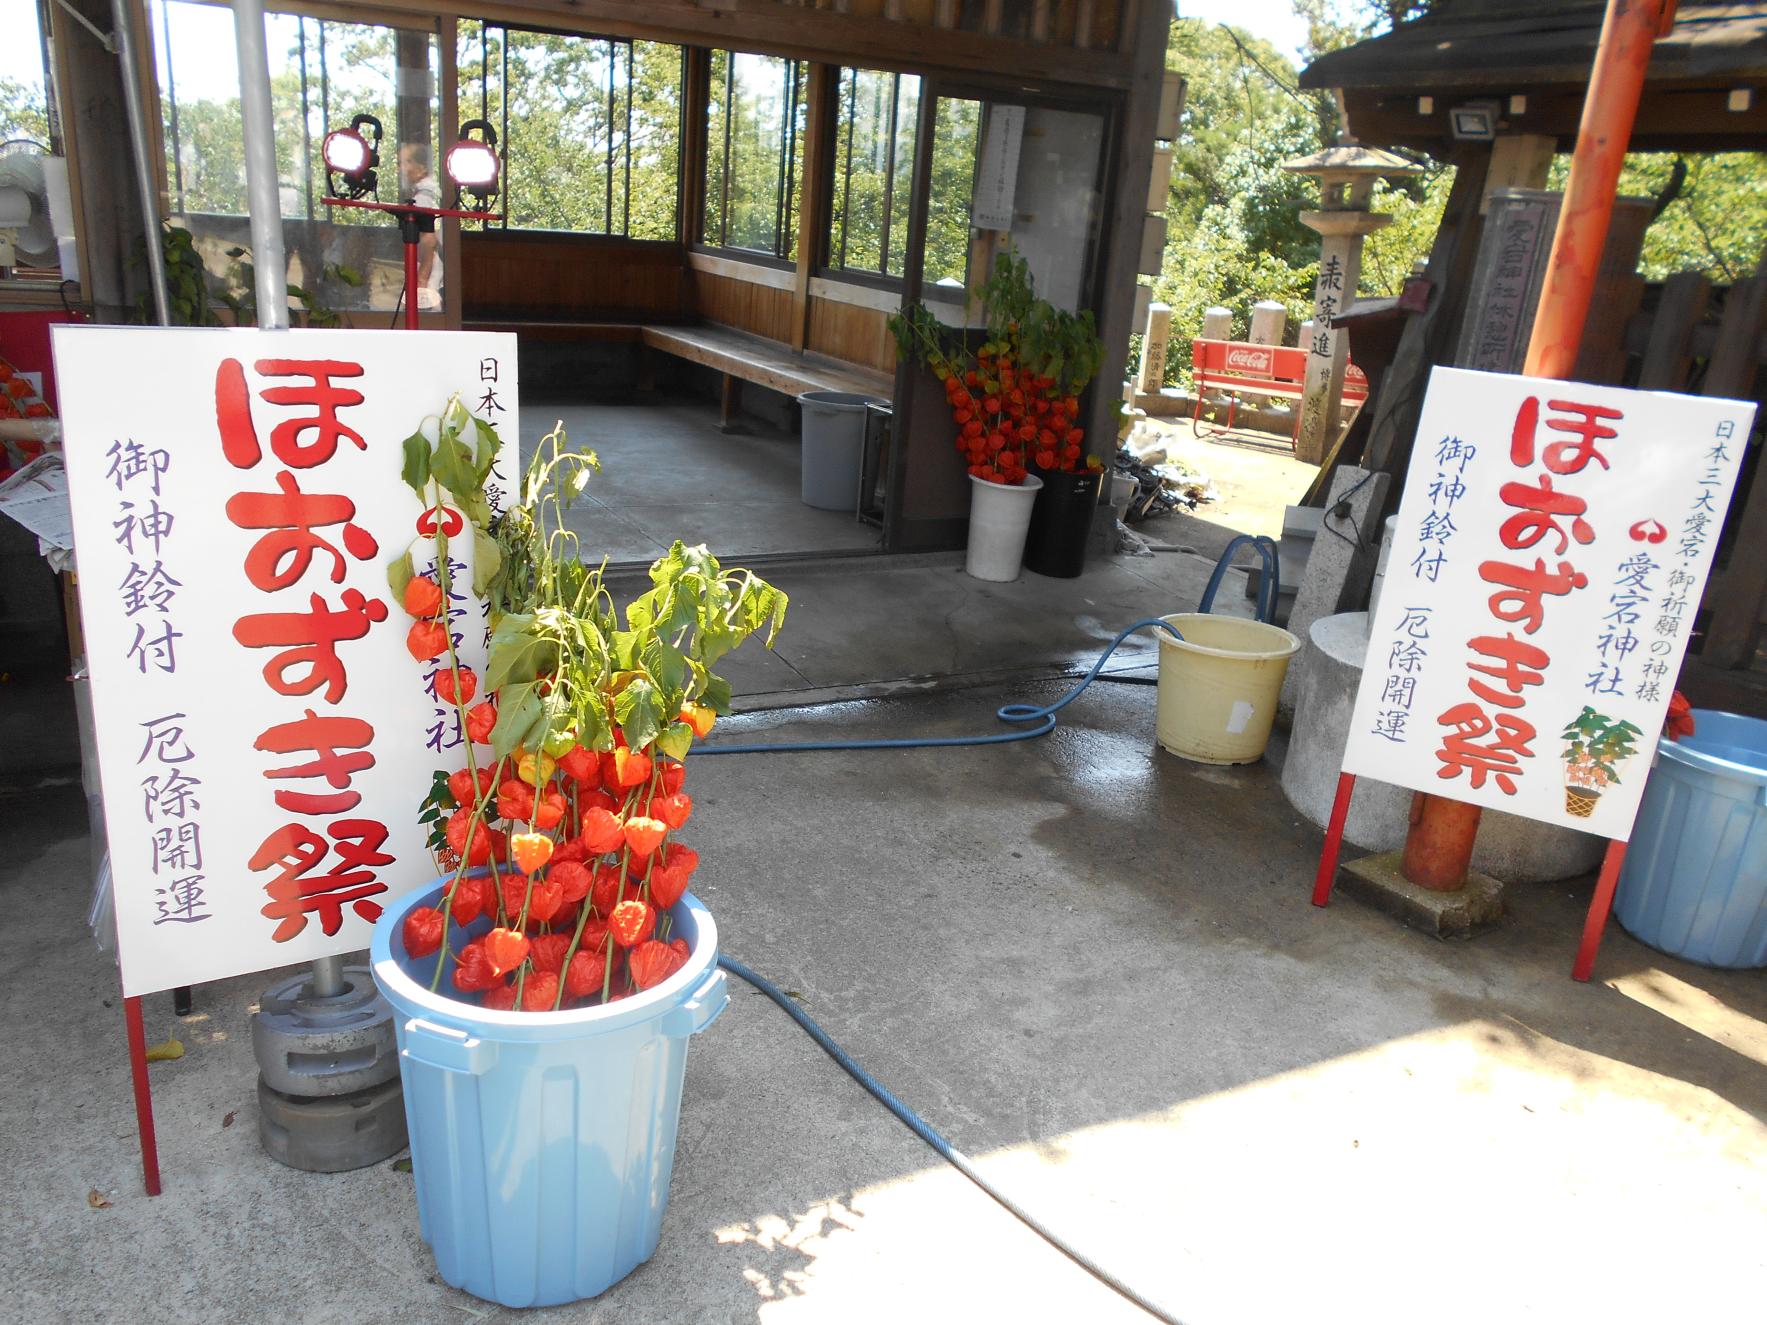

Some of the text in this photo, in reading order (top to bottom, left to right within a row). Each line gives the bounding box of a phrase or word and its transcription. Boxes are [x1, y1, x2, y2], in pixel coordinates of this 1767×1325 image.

[106, 438, 213, 926] 御神鈴付 厄除開運
[216, 358, 395, 942] ほおずき祭
[1370, 435, 1477, 743] 御神鈴付 厄除開運
[1435, 395, 1622, 795] ほおずき祭
[1585, 552, 1661, 699] 愛宕神社
